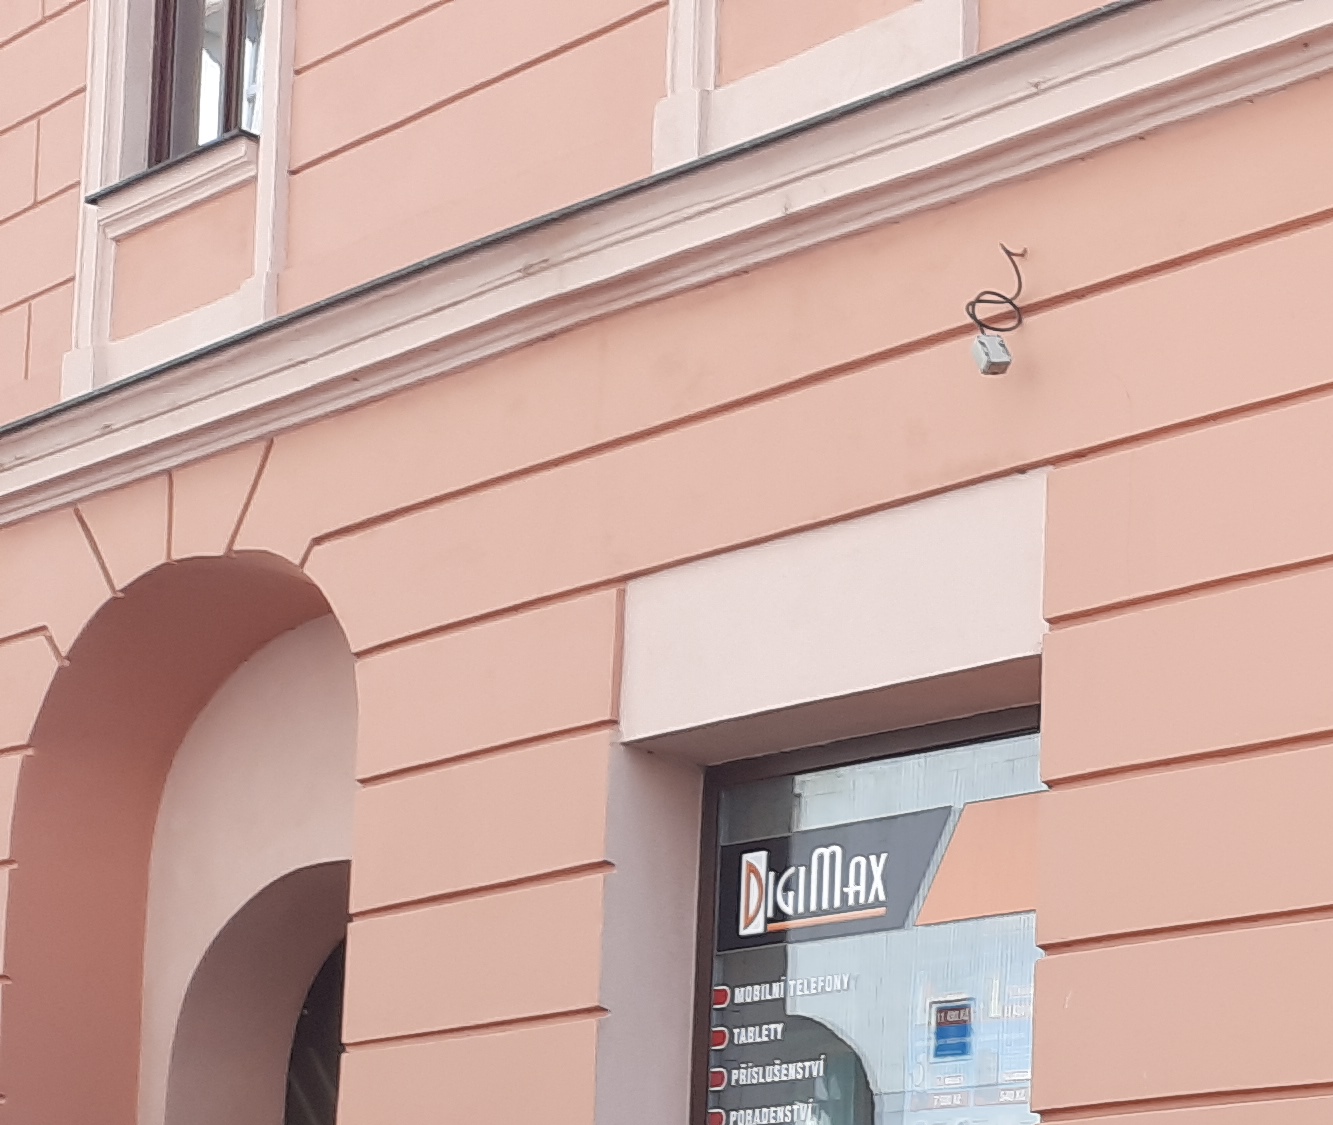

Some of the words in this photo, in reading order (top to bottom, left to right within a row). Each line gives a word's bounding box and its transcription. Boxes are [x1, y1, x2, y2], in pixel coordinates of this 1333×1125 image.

[734, 976, 786, 1003] MOBILNÍ
[788, 973, 850, 997] TELEFONY
[733, 1022, 785, 1045] TABLETY
